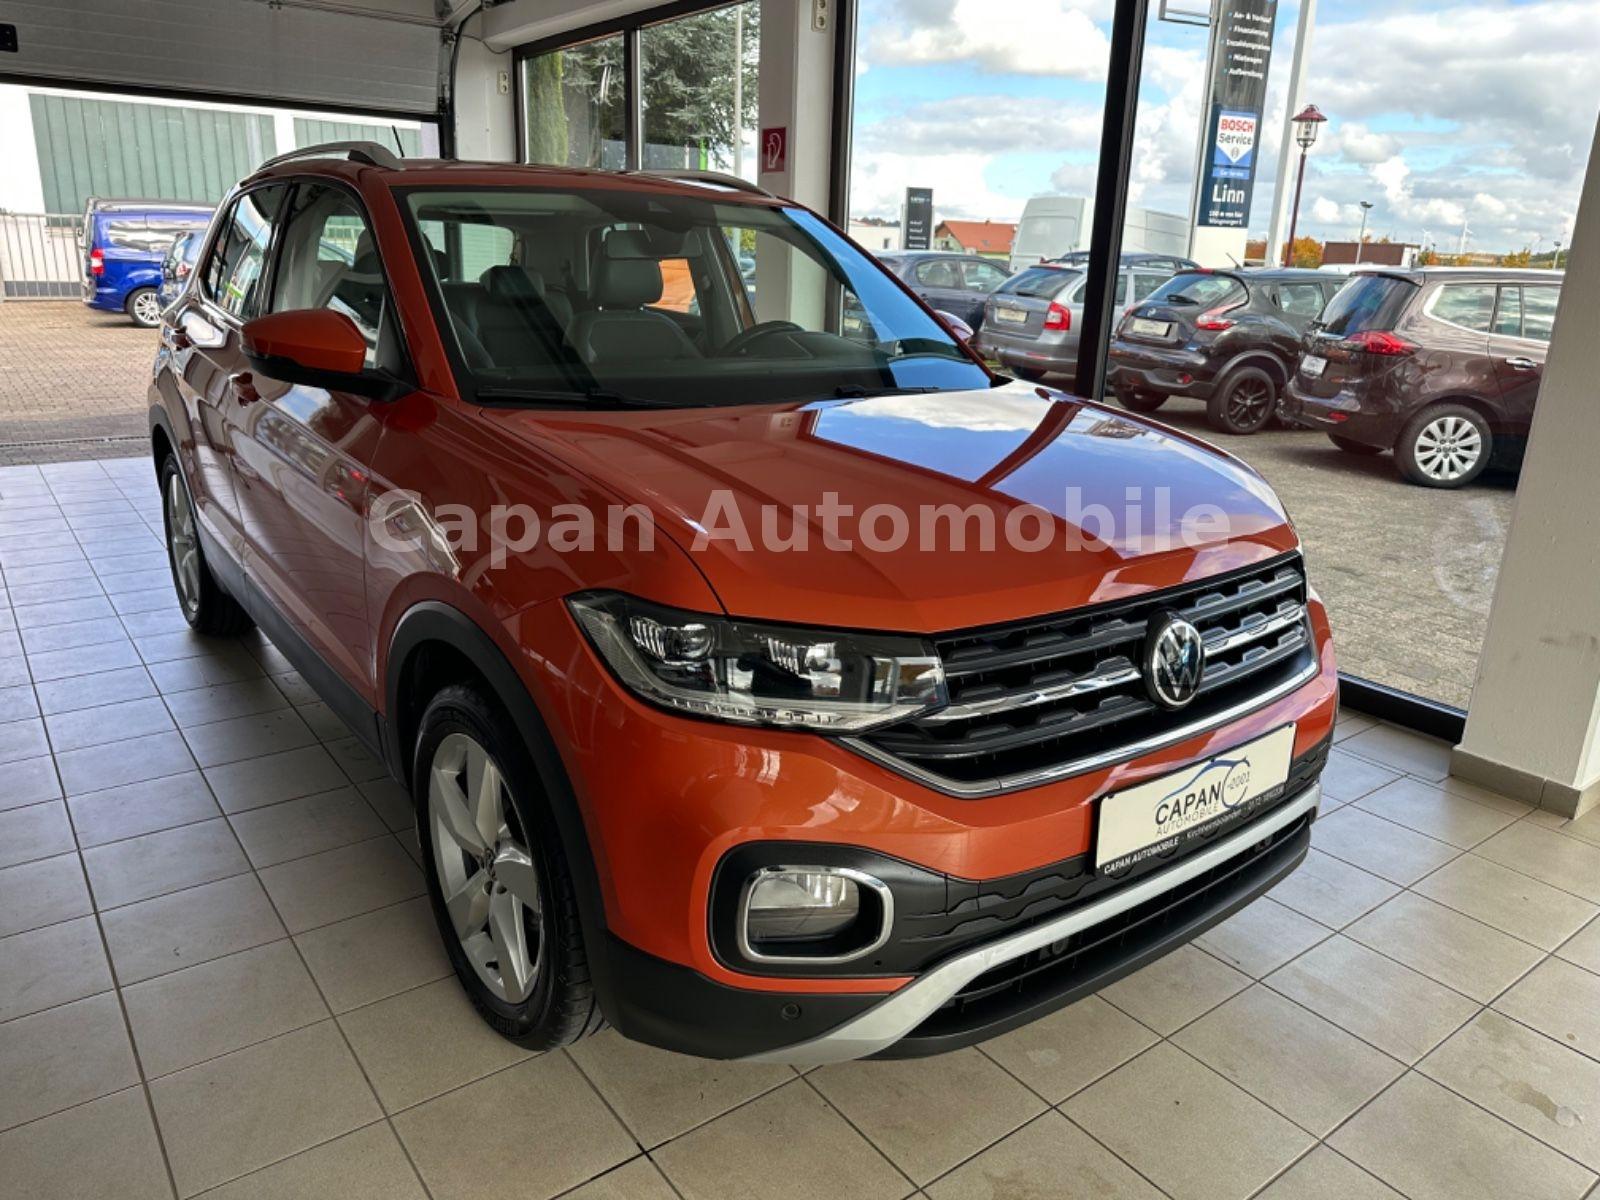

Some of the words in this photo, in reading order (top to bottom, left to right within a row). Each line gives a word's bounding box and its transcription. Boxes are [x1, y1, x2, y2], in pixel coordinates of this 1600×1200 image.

[1218, 132, 1253, 146] Service
[1220, 118, 1254, 133] BOSCH
[1212, 184, 1246, 204] Linn
[1154, 781, 1221, 826] CAPAN
[1156, 802, 1220, 837] AUTOMOBILE
[1104, 856, 1131, 875] CAPAN
[1131, 836, 1180, 863] AUTOMOBILE
